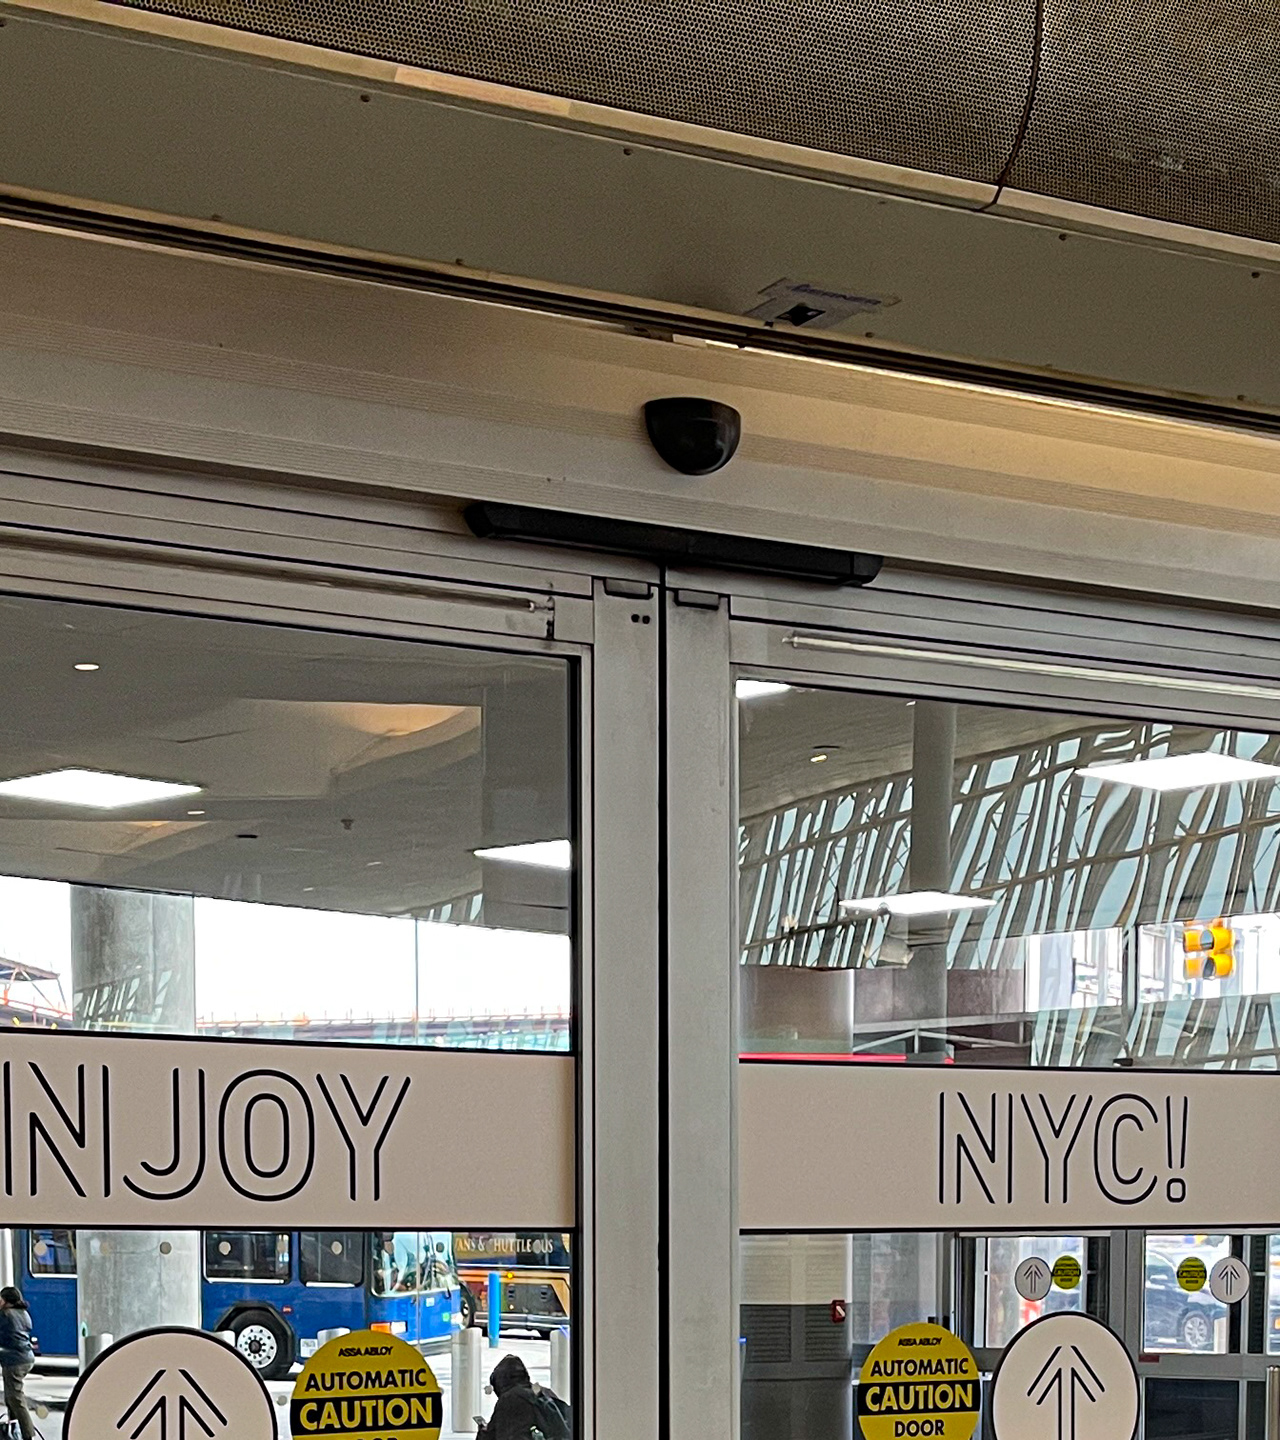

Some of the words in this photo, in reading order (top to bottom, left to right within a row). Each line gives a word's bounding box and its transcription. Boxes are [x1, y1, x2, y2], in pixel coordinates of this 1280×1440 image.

[938, 1091, 1188, 1206] NYC!
[493, 1238, 532, 1253] HUTTLE
[338, 1347, 362, 1357] ASSA
[364, 1346, 393, 1356] ABLOY
[870, 1357, 969, 1377] AUTOMATIC
[305, 1368, 427, 1392] AUTOMATIC
[865, 1383, 973, 1412] CAUTION
[299, 1396, 433, 1431] CAUTION
[894, 1418, 945, 1437] DOOR
